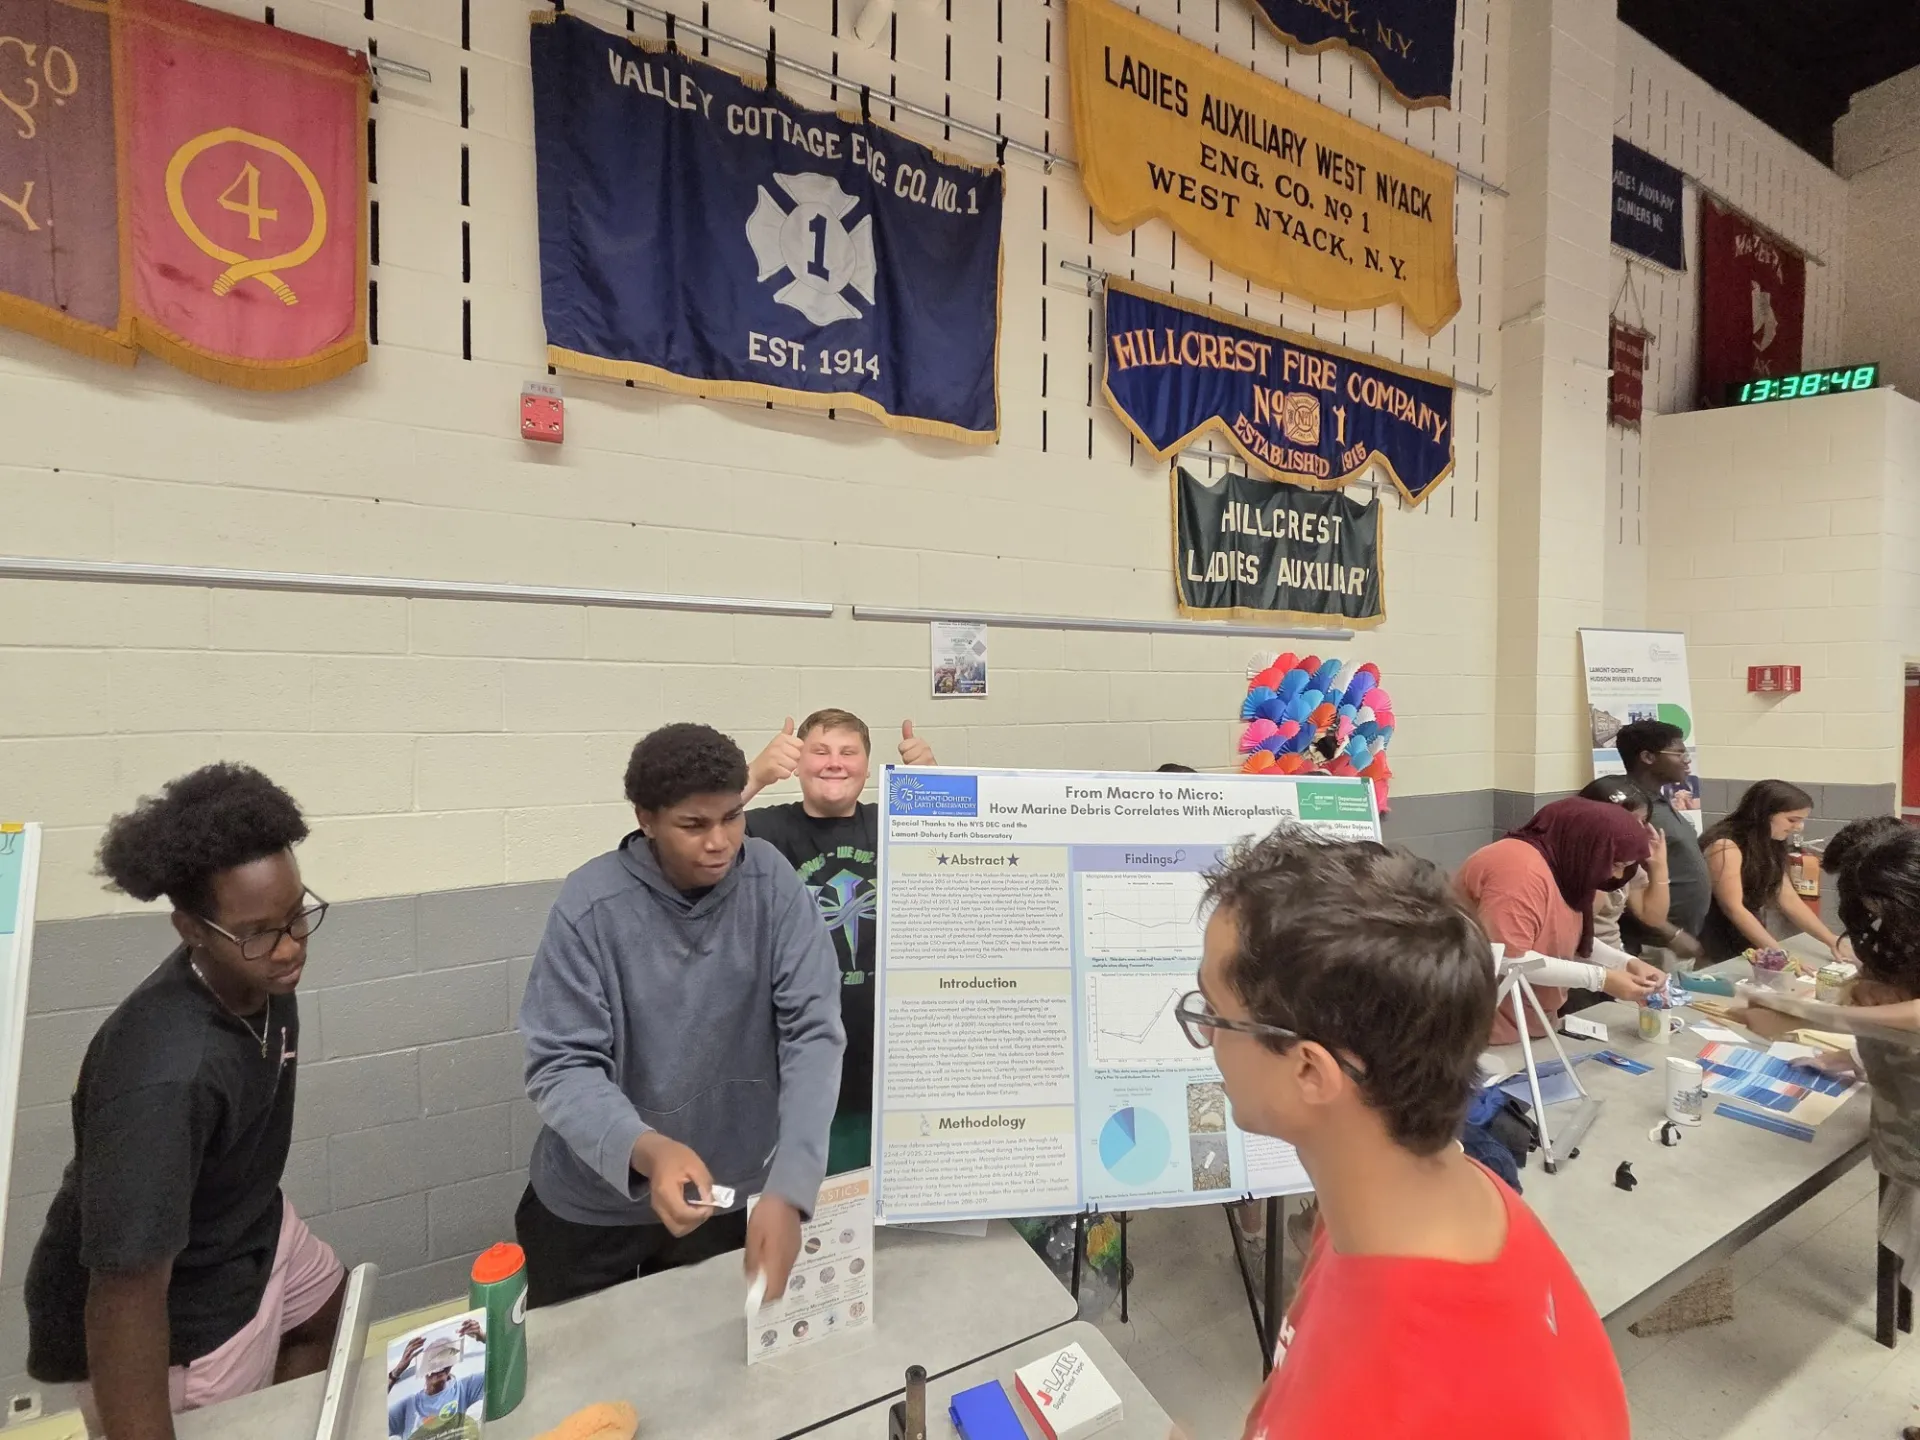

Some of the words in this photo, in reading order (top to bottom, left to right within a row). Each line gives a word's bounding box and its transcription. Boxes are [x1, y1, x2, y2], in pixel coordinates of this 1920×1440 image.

[608, 48, 714, 120] VALLEY
[727, 104, 842, 161] COTTAGE
[894, 164, 927, 203] CO.
[932, 177, 962, 213] NO.
[967, 189, 979, 214] 1
[1105, 46, 1188, 118] LADIES
[1200, 94, 1308, 168] AUXILIARY
[1315, 142, 1366, 194] WEST
[1376, 171, 1433, 223] NYACK
[217, 161, 278, 241] 4
[1199, 142, 1264, 189] ENG.
[1274, 175, 1314, 210] CO.
[1362, 212, 1370, 233] 1
[1147, 161, 1239, 217] WEST
[1255, 202, 1353, 265] NYACK,
[807, 213, 830, 281] 1
[749, 331, 806, 371] EST.
[819, 348, 880, 380] 1914
[531, 384, 556, 394] FIRE
[1112, 329, 1271, 378] HILLCREST
[1282, 348, 1337, 393] FIRE
[1347, 370, 1447, 444] COMPANY
[1740, 367, 1875, 402] 13:38:48
[1332, 405, 1346, 447] 1
[1341, 440, 1367, 472] 1915
[1221, 501, 1342, 545] HILLCREST
[1187, 549, 1259, 585] LADIES
[1277, 557, 1370, 595] AUXILIAR
[901, 788, 913, 801] 75
[989, 803, 1018, 814] How
[1021, 804, 1067, 814] Marine
[1071, 804, 1111, 815] Debris
[1114, 804, 1180, 816] Correlates
[1183, 805, 1209, 815] With
[1213, 805, 1292, 819] Microplastics
[1066, 786, 1102, 799] From
[1107, 787, 1155, 799] Macro
[1159, 789, 1173, 799] to
[1178, 788, 1224, 800] Micro:
[892, 820, 919, 828] Special
[951, 854, 1005, 865] Abstract
[1124, 853, 1173, 866] Findings
[939, 977, 1017, 989] Introduction
[939, 1114, 1026, 1130] Methodology
[1053, 1392, 1067, 1410] Super
[1064, 1376, 1076, 1392] Clear
[1073, 1361, 1085, 1376] Tape
